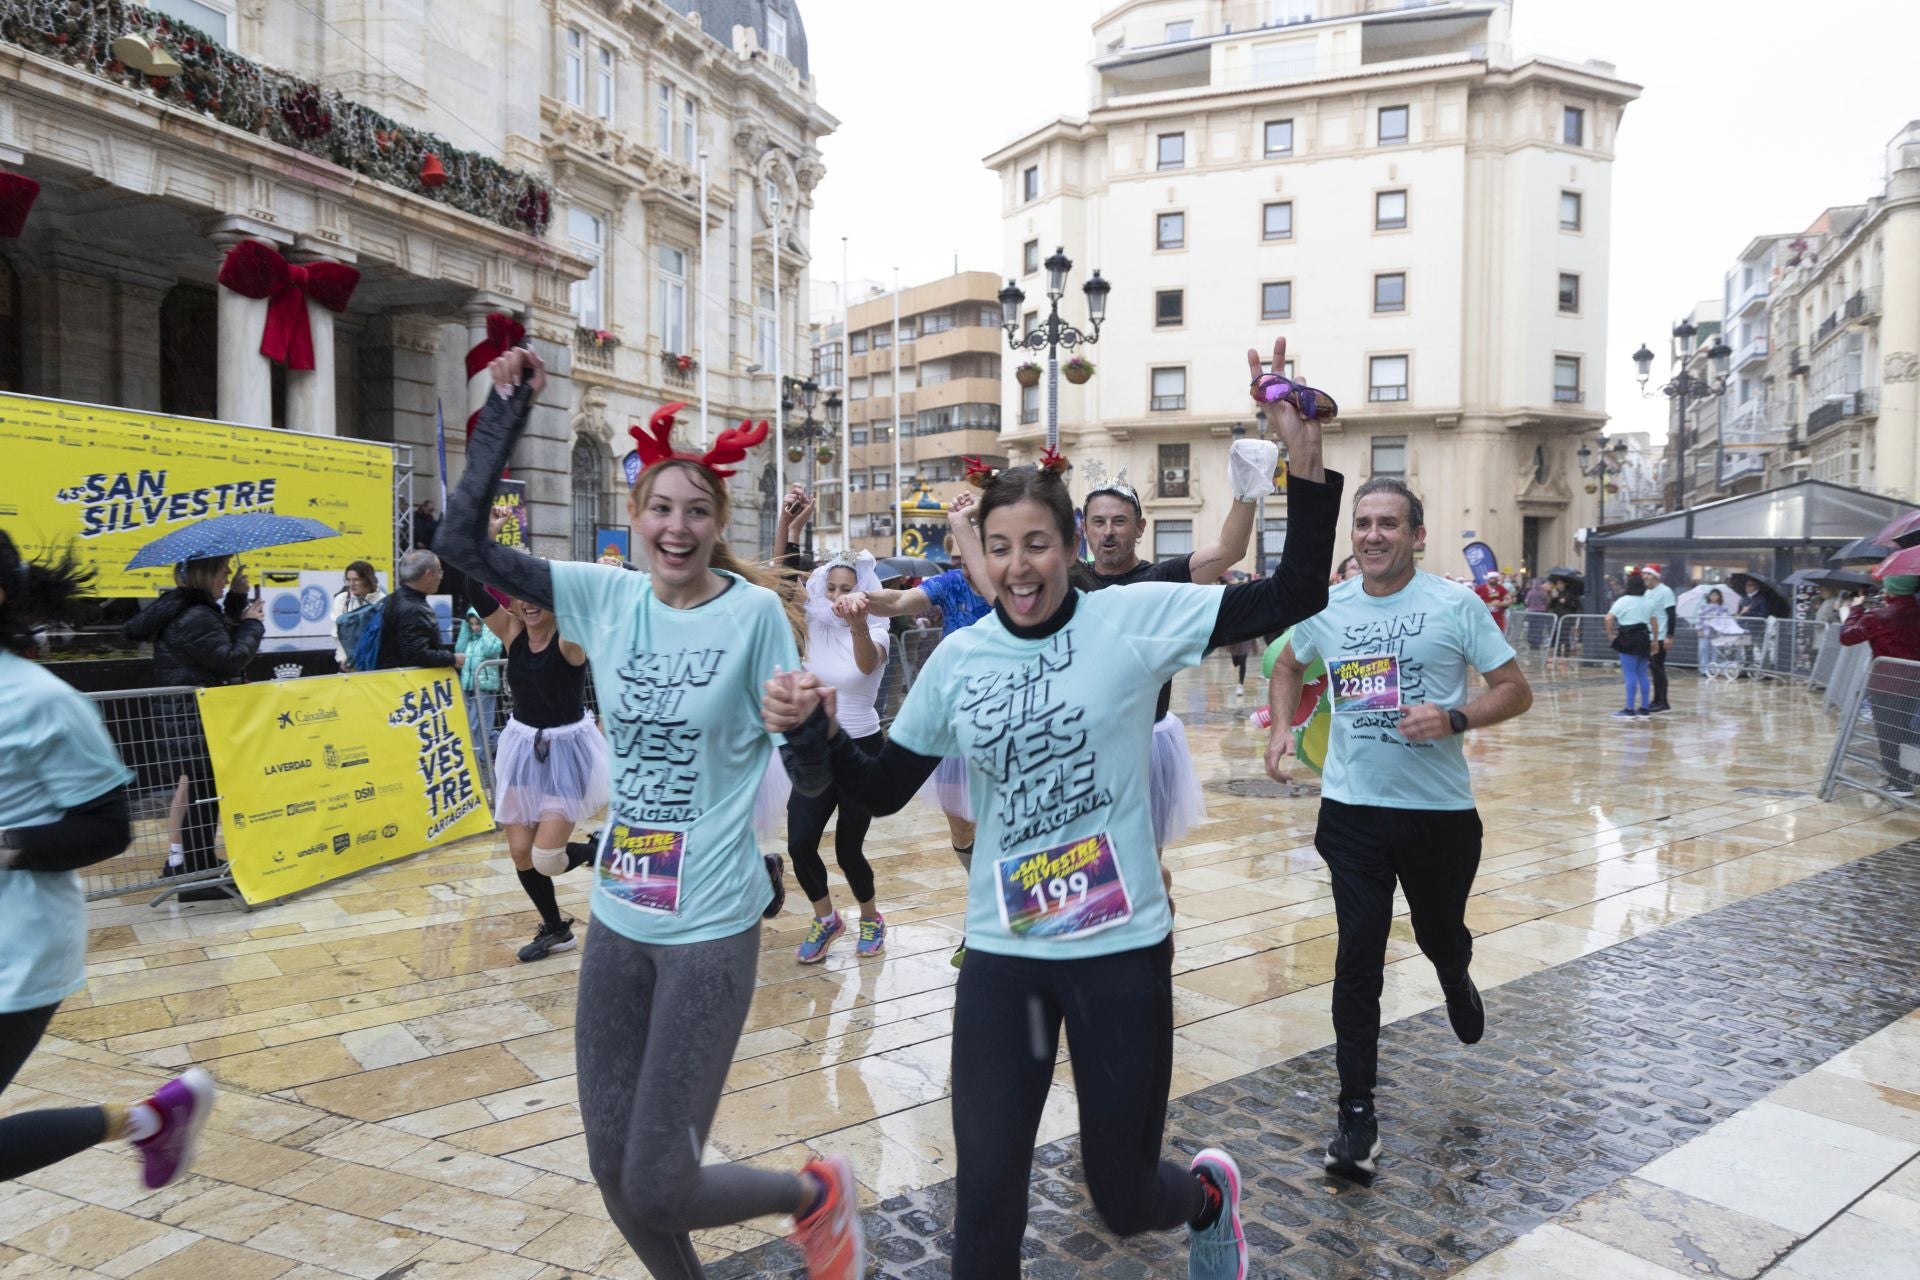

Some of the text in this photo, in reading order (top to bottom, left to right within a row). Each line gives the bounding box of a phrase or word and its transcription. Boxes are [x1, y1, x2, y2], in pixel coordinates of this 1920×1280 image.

[80, 478, 277, 537] SILVESTRE
[82, 469, 168, 504] SAN
[1342, 613, 1426, 650] SAN
[961, 629, 1074, 711] SAN
[1340, 676, 1386, 697] 2288
[1341, 661, 1358, 673] SAN
[1341, 659, 1389, 679] SILVESTRE
[295, 707, 338, 722] CaixaBank
[402, 678, 453, 724] SAN
[612, 684, 688, 727] SIL
[971, 680, 1066, 749] SIL
[417, 712, 455, 753] SIL
[610, 727, 701, 766] VES
[971, 706, 1088, 784] VES
[277, 759, 312, 772] VERDAD
[417, 737, 464, 785] VES
[354, 786, 375, 800] DSM
[426, 768, 473, 817] TRE
[615, 762, 699, 806] TRE
[997, 751, 1096, 826] TRE
[427, 795, 481, 839] CARTAGENA
[609, 847, 651, 883] 201
[1020, 852, 1048, 876] SAN
[1022, 837, 1098, 891] SILVESTRE
[1030, 871, 1088, 913] 199
